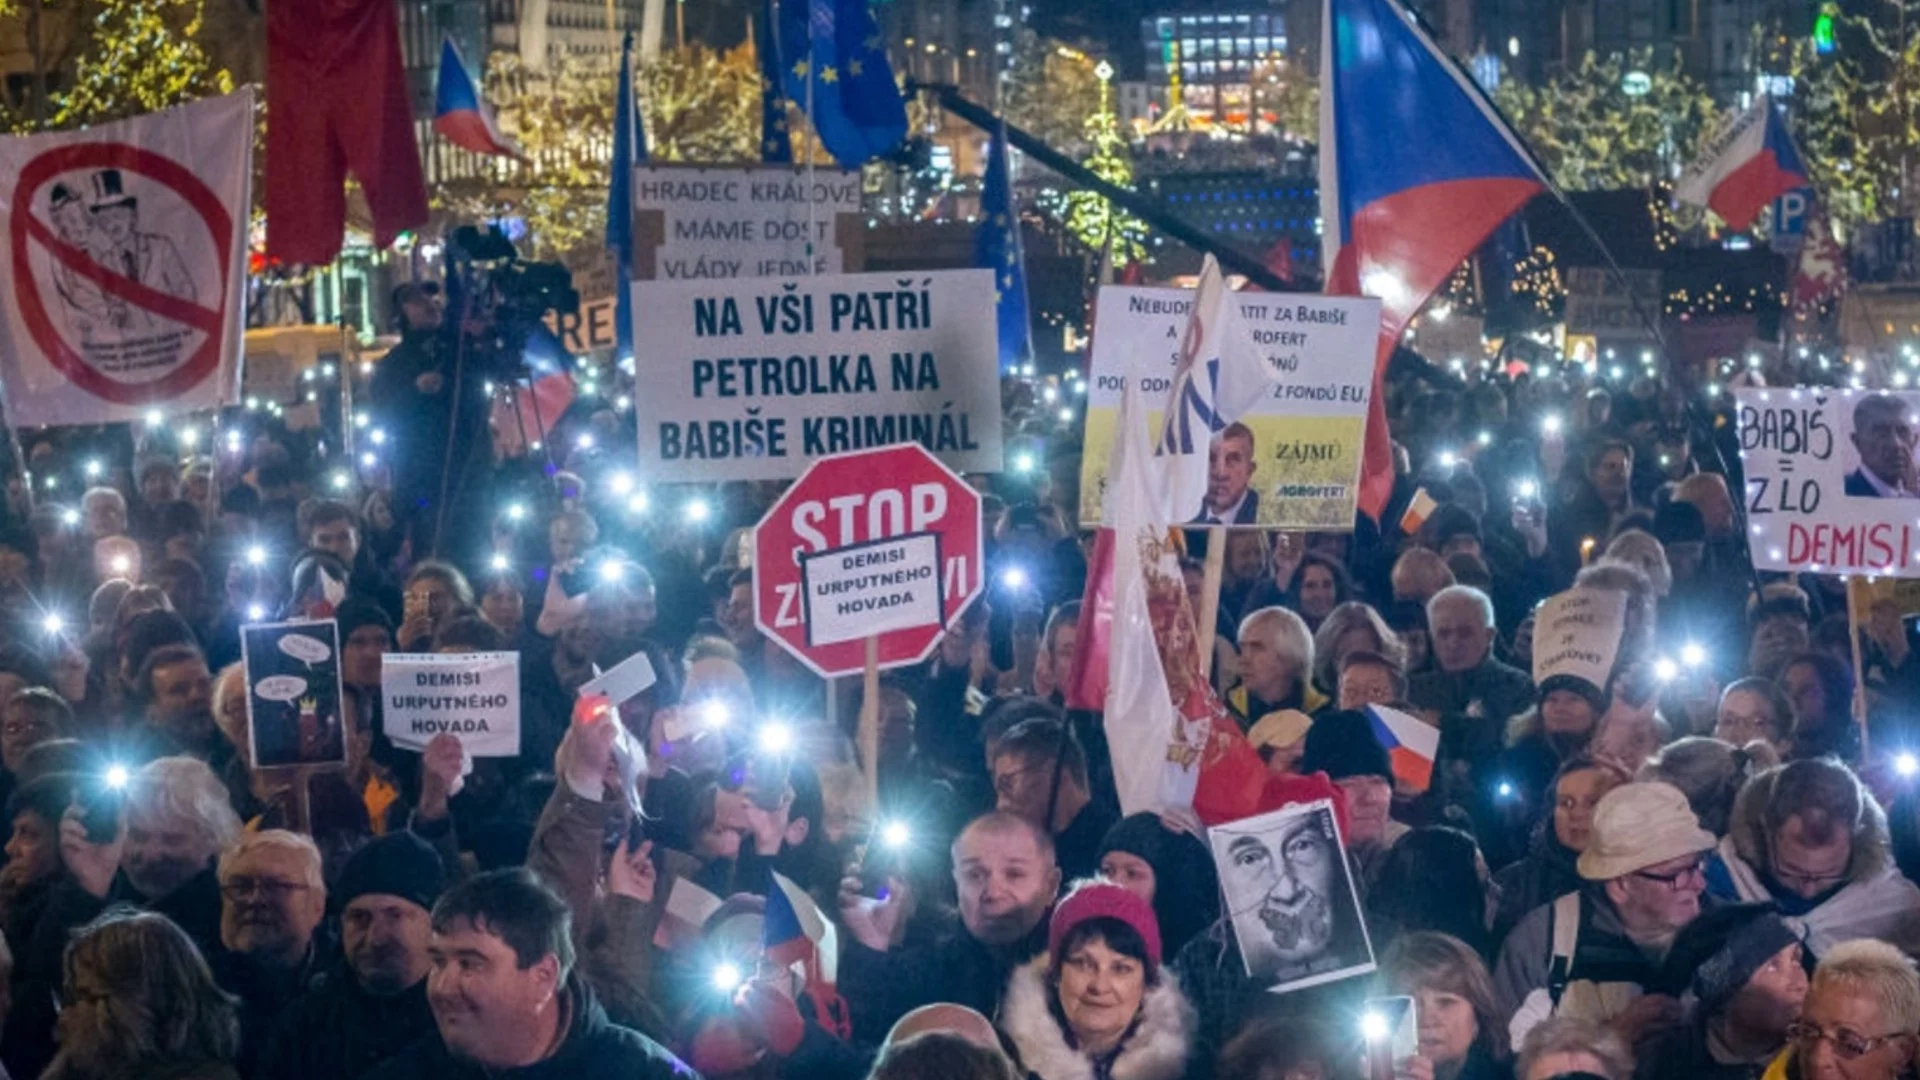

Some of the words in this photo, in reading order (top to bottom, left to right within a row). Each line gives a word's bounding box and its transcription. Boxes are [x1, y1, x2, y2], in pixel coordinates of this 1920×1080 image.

[641, 180, 739, 202] HRADEC
[751, 177, 858, 204] KRÁLOVÉ
[1781, 192, 1805, 231] P
[674, 216, 755, 241] MÁME
[663, 255, 743, 279] VLÁDY
[694, 296, 743, 337] NA
[756, 283, 814, 336] VŠI
[830, 278, 932, 332] PATŘÍ
[1274, 308, 1293, 321] ZA
[1297, 305, 1348, 326] BABIŠE
[1252, 329, 1308, 347] ROFERT
[692, 354, 877, 398] PETROLKA
[890, 352, 940, 391] NA
[1274, 384, 1283, 399] Z
[659, 406, 787, 460] BABIŠE
[802, 401, 980, 455] KRIMINÁL
[1741, 397, 1834, 461] BABIŠ
[1749, 477, 1821, 514] ZLO
[791, 481, 948, 568] STOP
[842, 547, 906, 571] DEMISI
[837, 590, 915, 615] HOVADA
[415, 671, 481, 687] DEMISI
[391, 693, 508, 710] URPUTNÉHO
[411, 718, 490, 734] HOVADA
